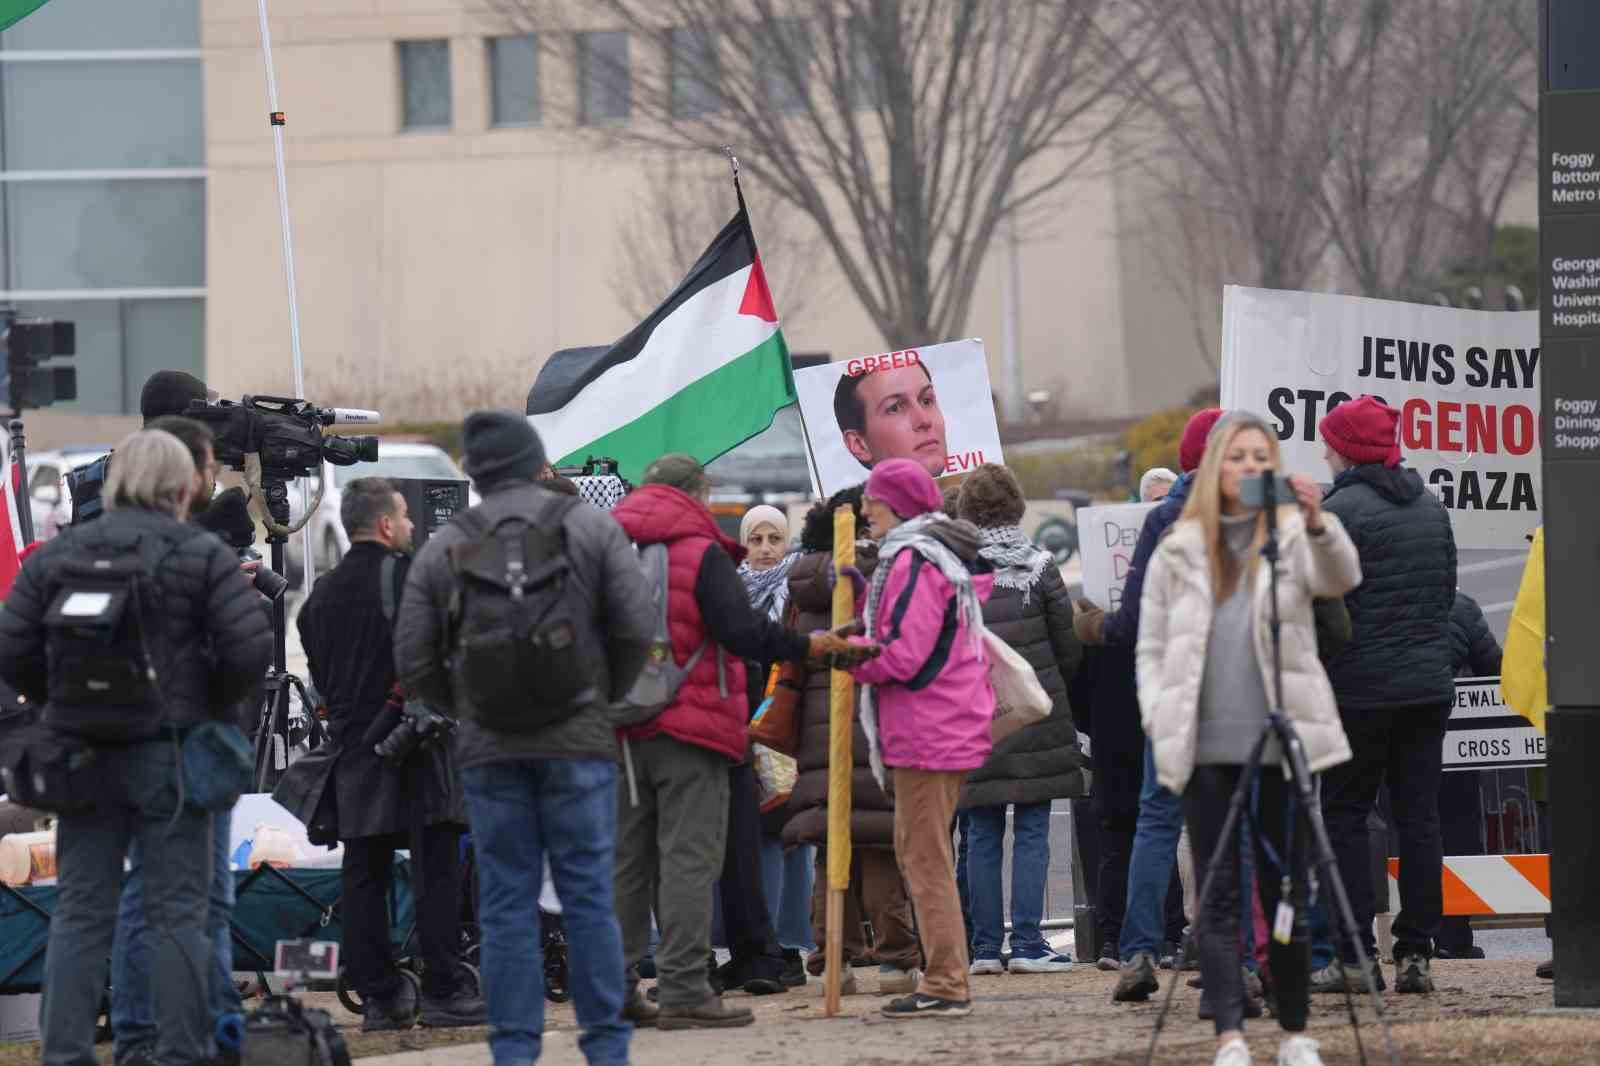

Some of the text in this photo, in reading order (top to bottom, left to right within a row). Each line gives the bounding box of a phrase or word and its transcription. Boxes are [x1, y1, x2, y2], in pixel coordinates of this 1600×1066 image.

[1552, 152, 1595, 168] Foggy
[1552, 189, 1595, 202] Metro
[1552, 294, 1600, 308] Univer
[847, 349, 920, 378] GREED
[1358, 335, 1540, 389] JEWS SAY
[1555, 398, 1598, 414] Foggy
[1267, 387, 1543, 456] ST GENO
[1555, 415, 1600, 432] Dining
[1555, 434, 1600, 450] Shopp
[943, 450, 986, 474] EVIL
[1429, 468, 1538, 511] GAZA
[1452, 689, 1506, 708] EWAL
[1458, 737, 1545, 758] CROSS HE
